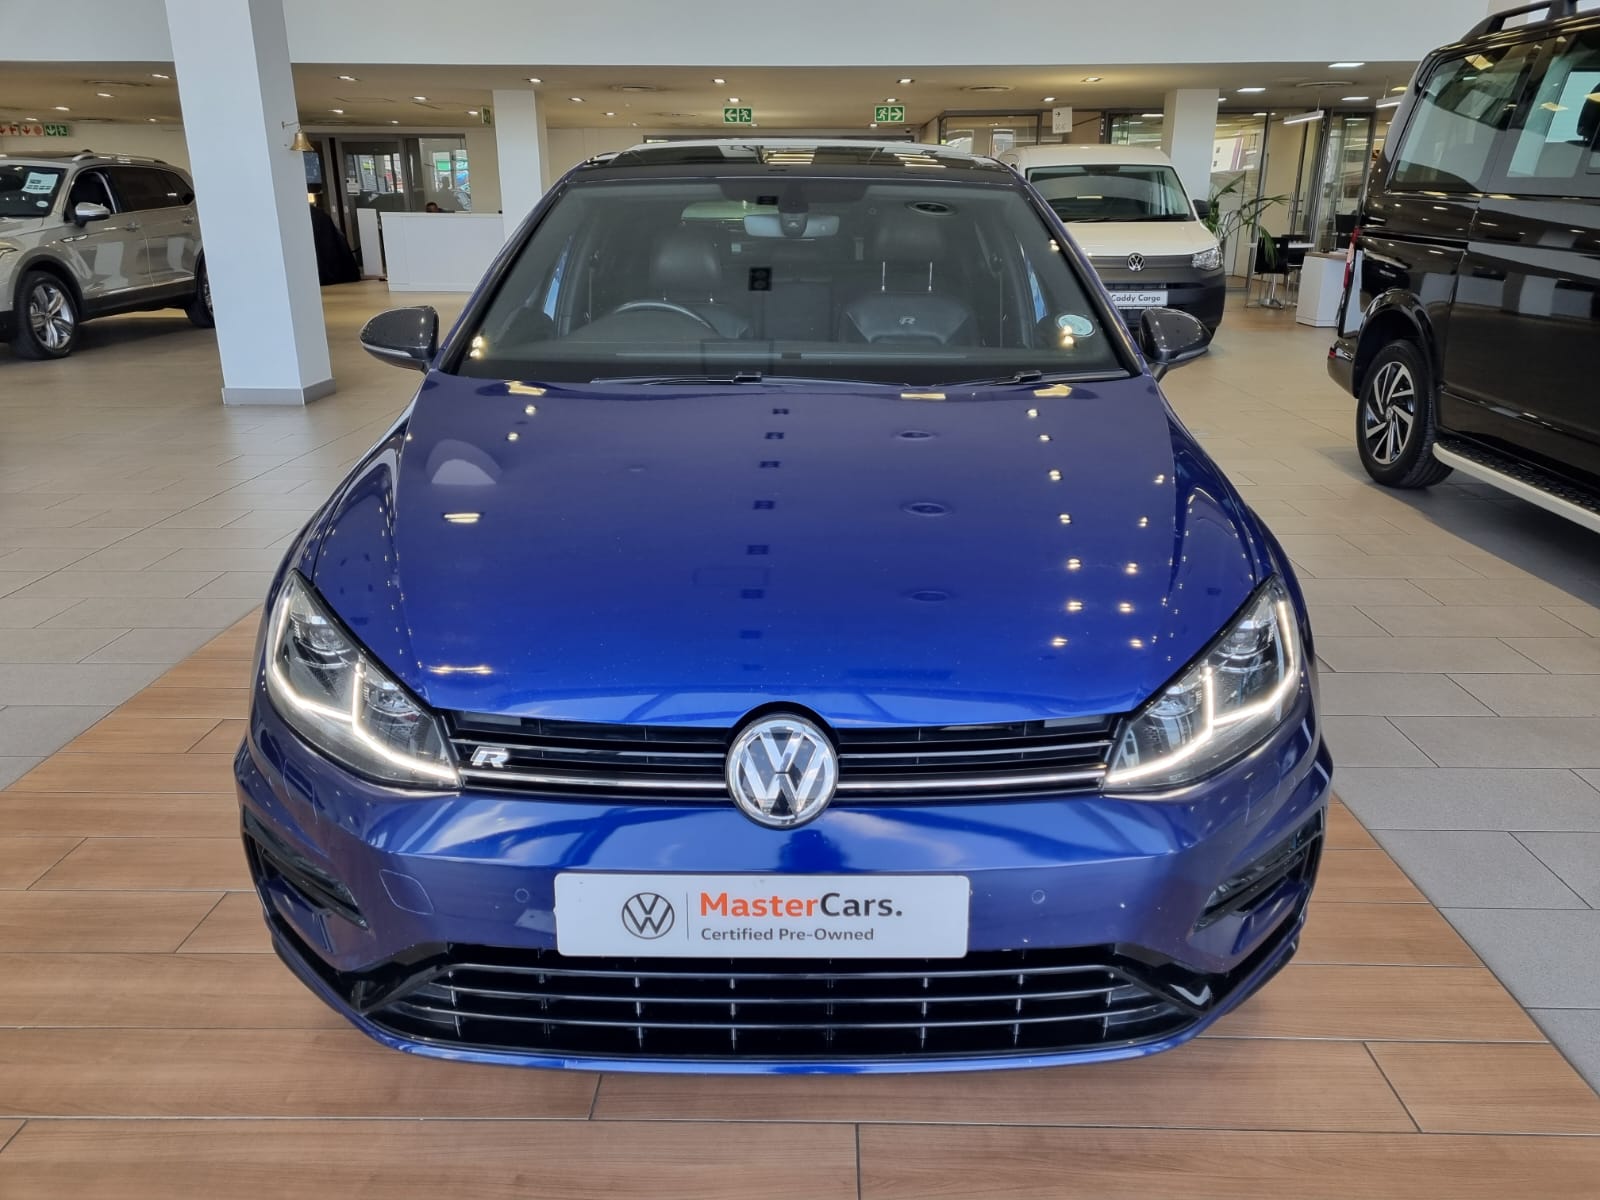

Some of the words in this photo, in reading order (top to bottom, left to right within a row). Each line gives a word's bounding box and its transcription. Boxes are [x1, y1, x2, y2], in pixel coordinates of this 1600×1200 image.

[1112, 294, 1136, 303] Caddy
[1138, 294, 1161, 303] Cargo
[470, 746, 510, 768] R
[700, 891, 903, 918] MasterCars.
[701, 927, 774, 941] Certified
[779, 927, 874, 942] Pre-Owned
